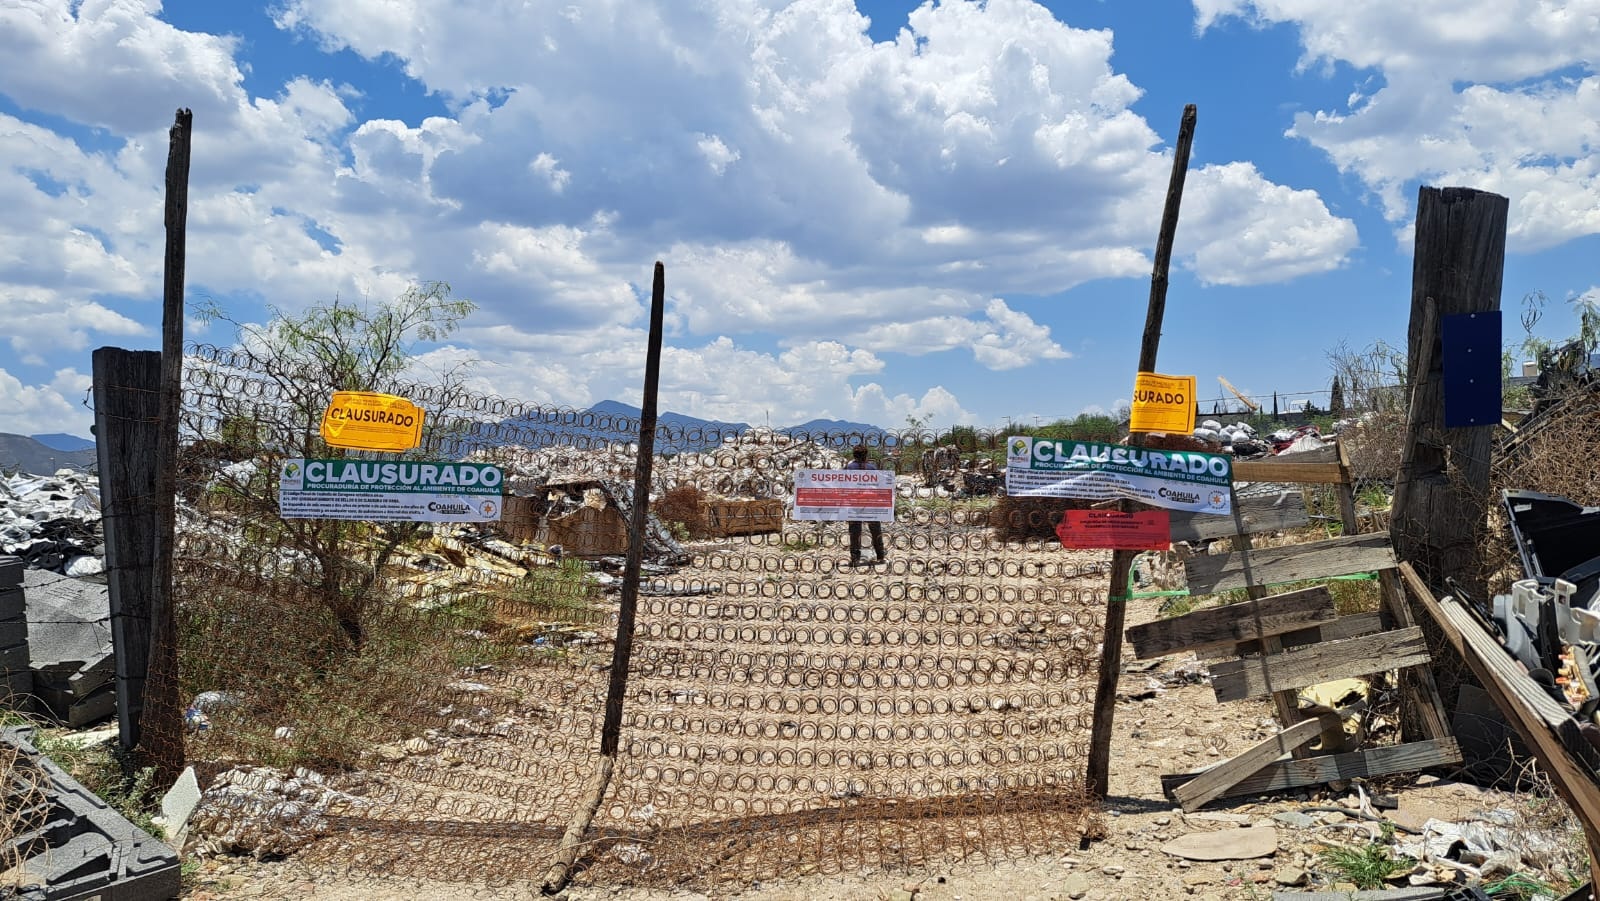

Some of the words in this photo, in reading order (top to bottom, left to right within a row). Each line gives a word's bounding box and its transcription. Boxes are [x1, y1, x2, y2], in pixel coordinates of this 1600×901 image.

[331, 407, 414, 427] CLAUSURADO
[1033, 440, 1229, 477] CLAUSURADO
[305, 461, 501, 487] CLAUSURADO
[811, 473, 878, 483] SUSPENSIÓN
[1034, 461, 1090, 469] PROCURAÍA
[1102, 463, 1143, 473] PROTECCIÓN
[1153, 470, 1186, 479] AMBIENTE
[1196, 475, 1229, 484] COAHUILA
[307, 482, 359, 490] PROCURADURÍA
[370, 483, 412, 491] PROTECCIÓN
[1158, 487, 1200, 500] COAHUILA
[428, 501, 470, 512] COAHUILA
